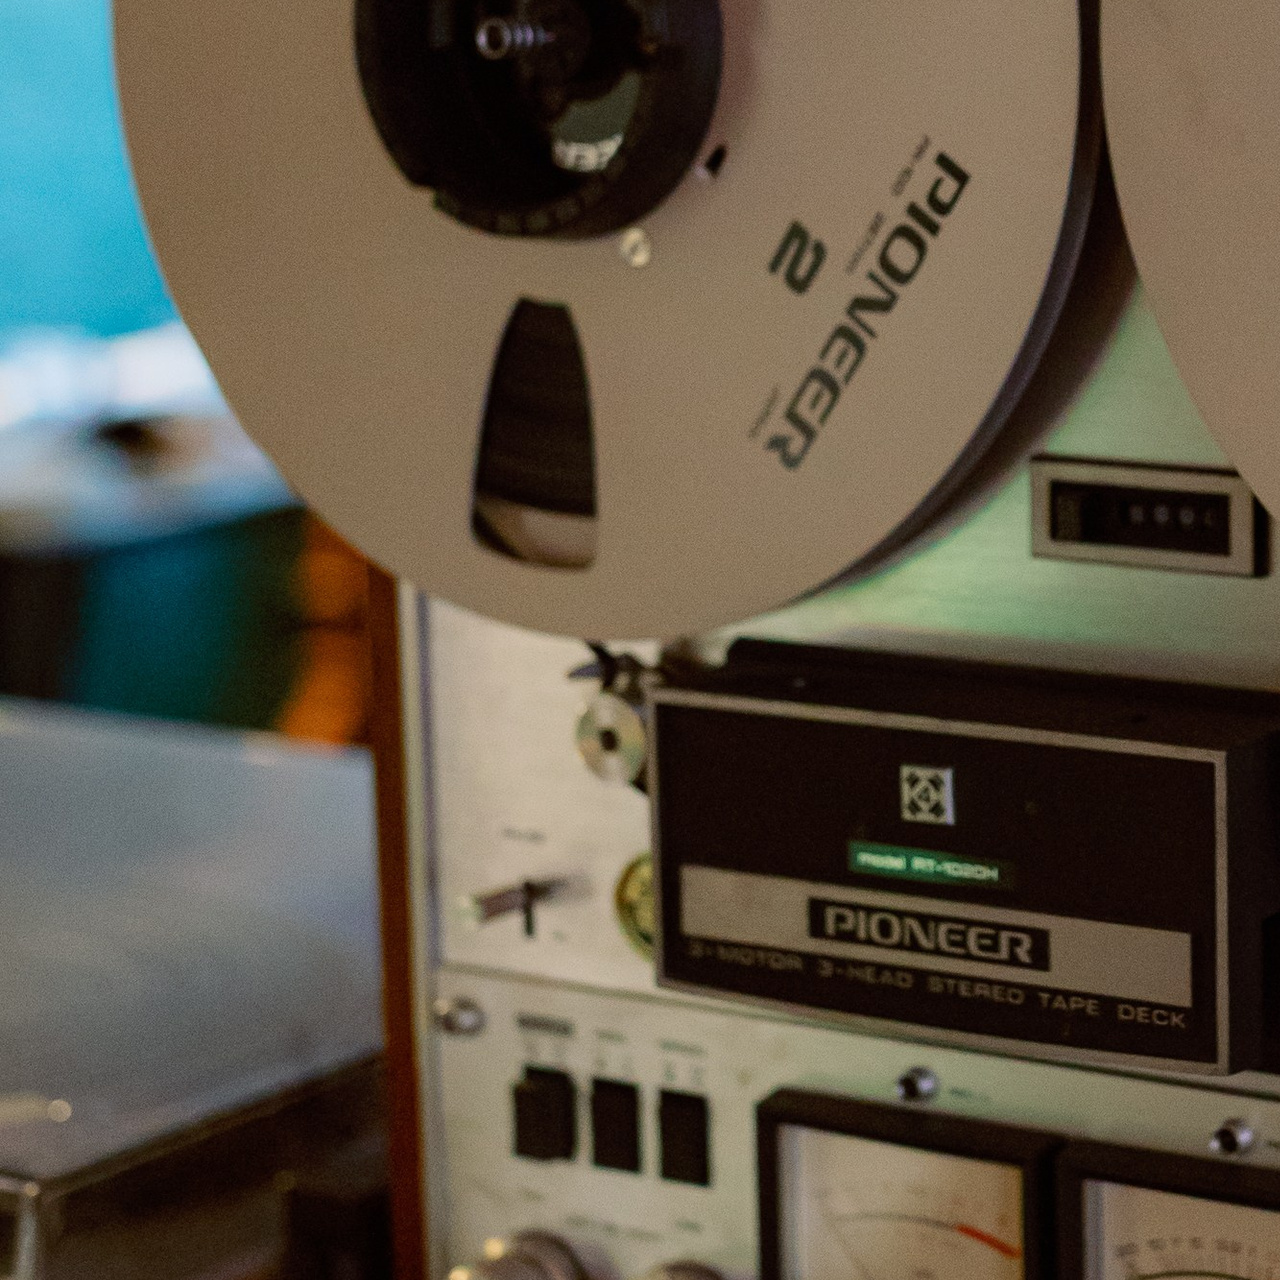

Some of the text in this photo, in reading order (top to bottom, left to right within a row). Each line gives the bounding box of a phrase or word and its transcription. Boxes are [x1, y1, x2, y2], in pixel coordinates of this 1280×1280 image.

[768, 221, 827, 294] 2
[764, 152, 971, 470] PIONEER
[824, 906, 1032, 963] PIONEER
[817, 959, 914, 989] 3-HEAD
[927, 975, 1025, 1006] STEREO
[1038, 991, 1100, 1017] TAPE
[1117, 1004, 1186, 1029] DECK
